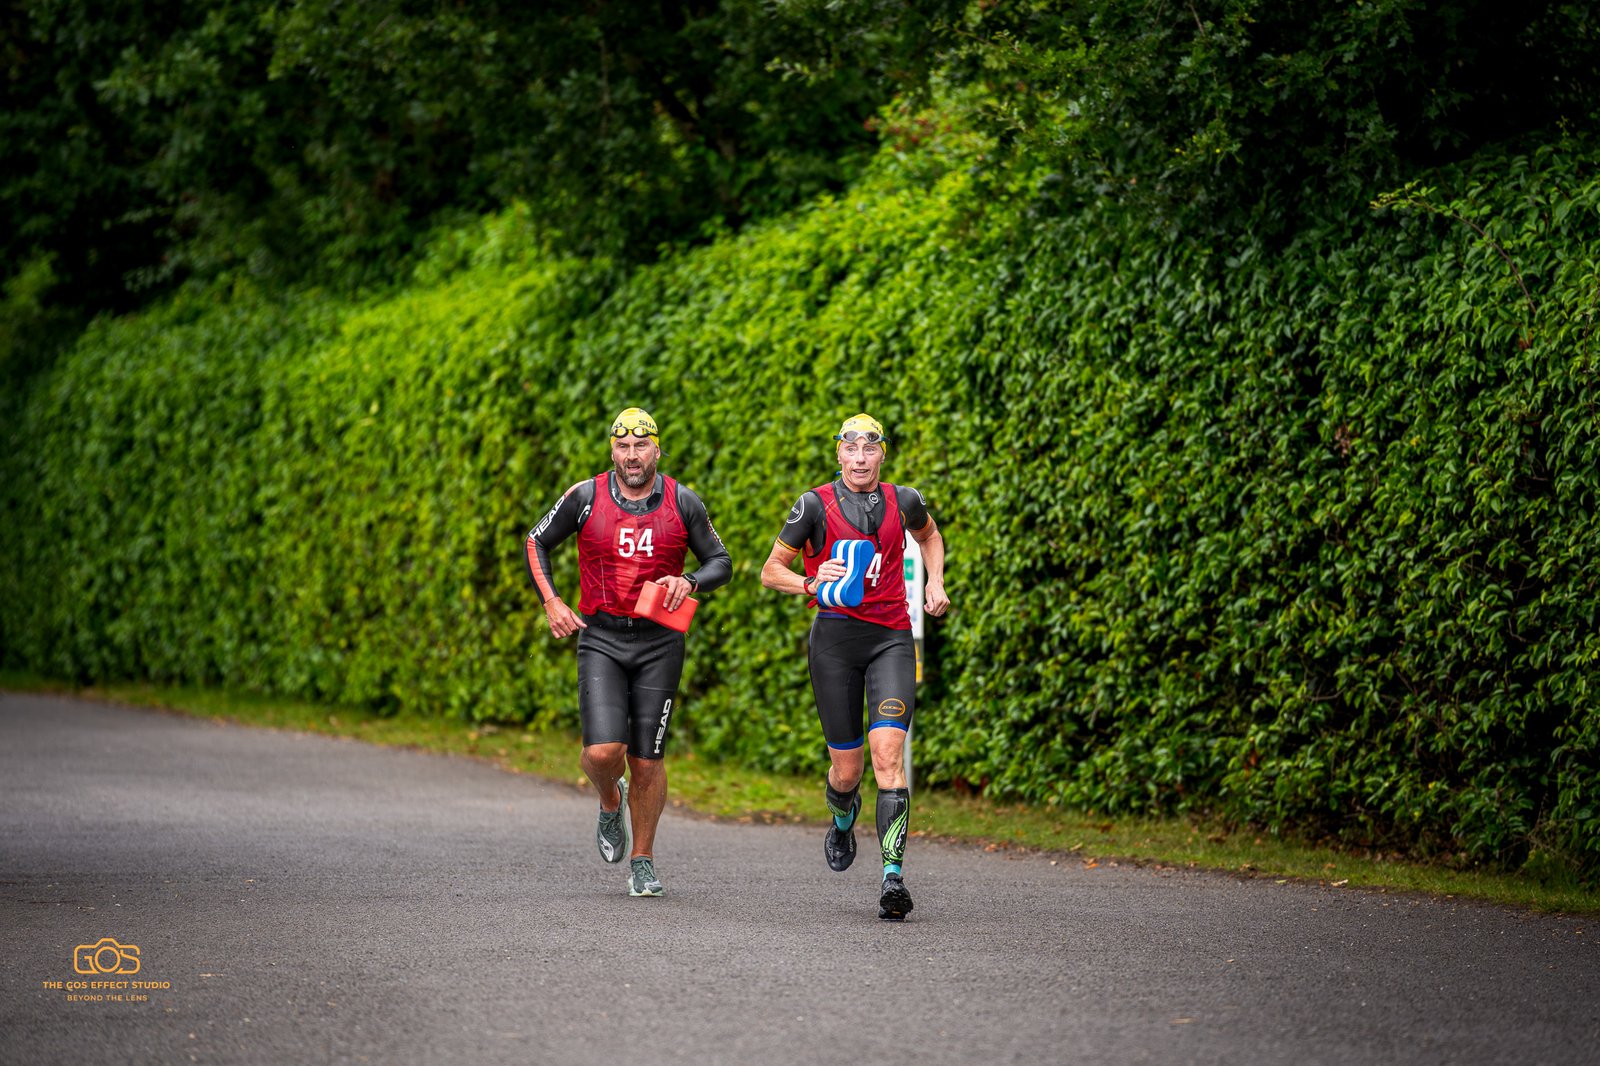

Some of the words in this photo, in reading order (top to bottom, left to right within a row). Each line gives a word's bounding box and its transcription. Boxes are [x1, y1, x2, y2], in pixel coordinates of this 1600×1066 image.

[529, 495, 566, 541] HEAD
[618, 527, 654, 558] 54
[654, 698, 672, 754] HEAD
